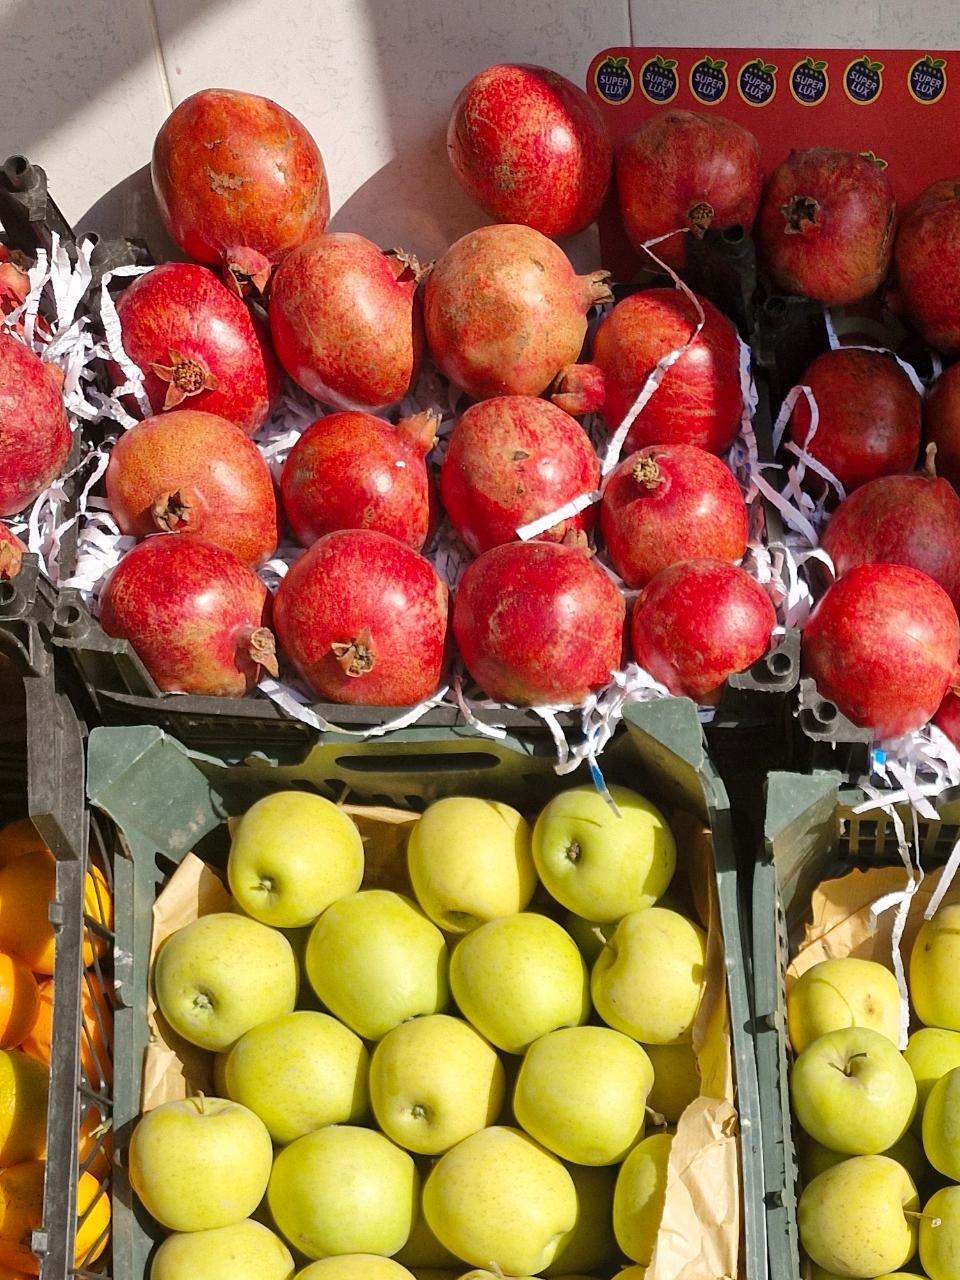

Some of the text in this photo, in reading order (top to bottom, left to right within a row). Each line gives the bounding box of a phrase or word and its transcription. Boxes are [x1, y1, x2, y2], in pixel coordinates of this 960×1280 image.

[600, 75, 629, 87] SUPER
[645, 72, 674, 90] SUPER
[695, 73, 723, 90] SUPER
[744, 73, 771, 93] SUPER
[795, 74, 823, 91] SUPER
[850, 71, 877, 92] SUPER
[913, 72, 941, 89] SUPER
[605, 84, 624, 95] LUX
[648, 82, 667, 96] LUX
[698, 83, 716, 97] LUX
[745, 82, 764, 99] LUX
[798, 84, 817, 97] LUX
[851, 81, 869, 97] LUX
[916, 82, 935, 96] LUX
